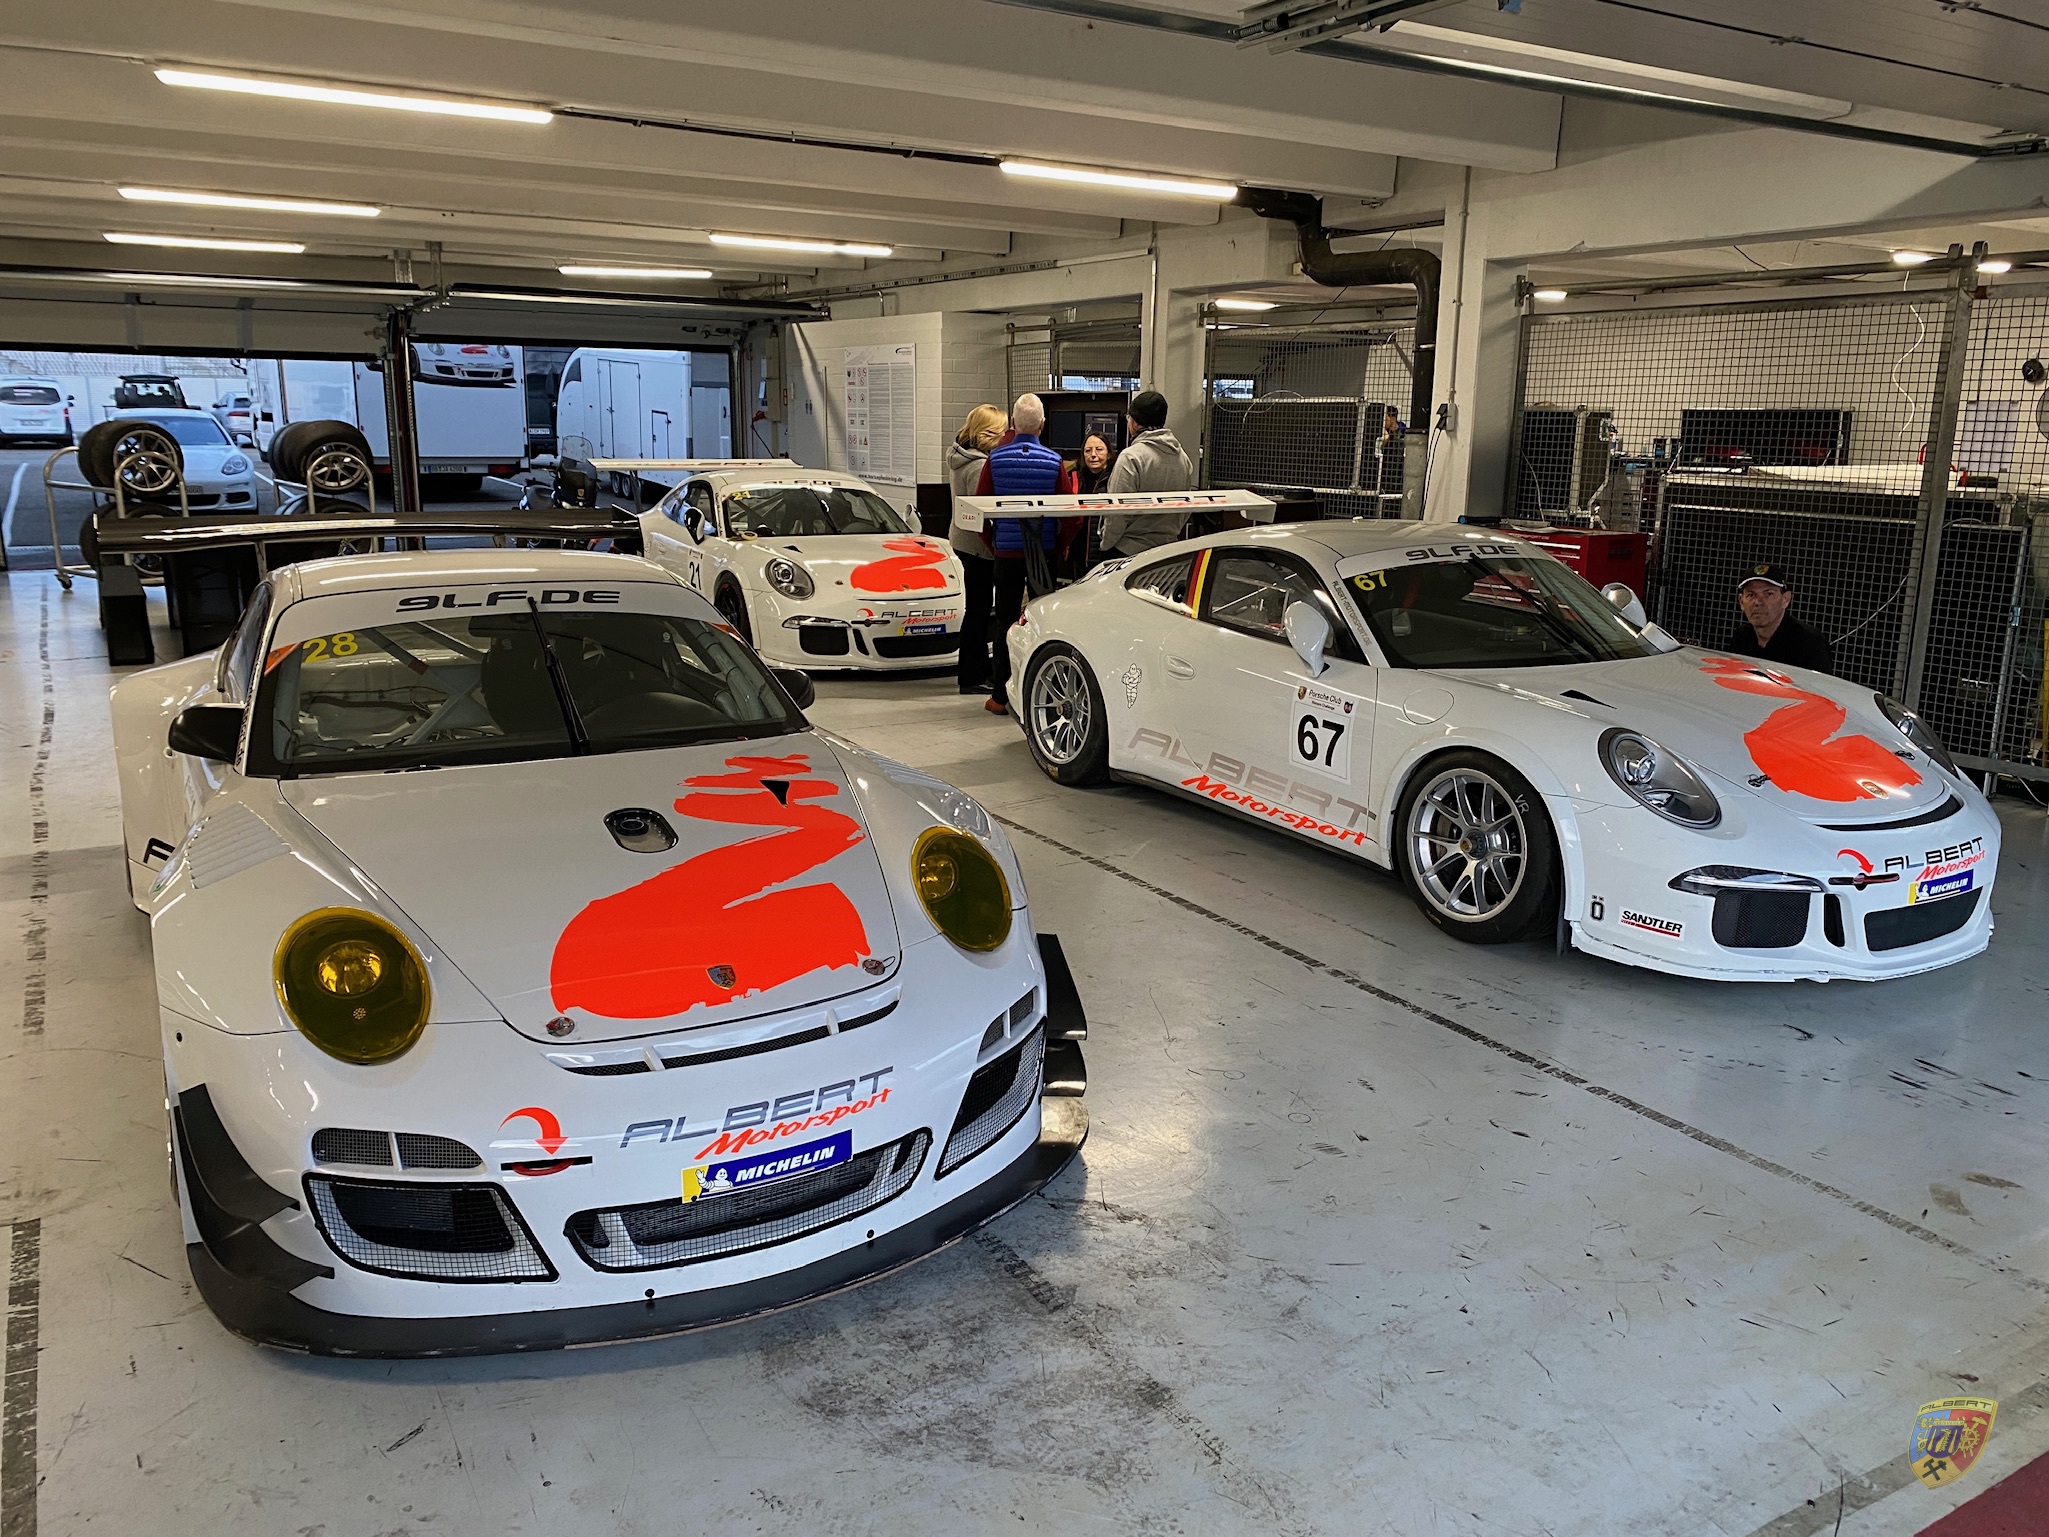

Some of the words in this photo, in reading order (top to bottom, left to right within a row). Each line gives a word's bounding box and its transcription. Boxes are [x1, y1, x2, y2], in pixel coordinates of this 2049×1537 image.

[732, 490, 752, 501] 21
[1406, 545, 1519, 561] 9LF.DE
[689, 561, 701, 591] 21
[1354, 570, 1388, 591] 67
[902, 614, 957, 625] Motorsport
[912, 626, 942, 634] MICHELIN
[302, 632, 358, 664] 28
[1308, 689, 1329, 701] Porsche
[1330, 695, 1342, 705] Club
[1297, 714, 1345, 767] 67
[1128, 727, 1377, 828] ALBERT
[1181, 774, 1368, 846] Motorsport
[1515, 793, 1530, 814] VR
[1885, 836, 1983, 872] ALBERT
[1915, 850, 1985, 881] Motorsport
[1930, 878, 1968, 895] MICHELIN
[1622, 910, 1683, 933] SANDTLER
[620, 1066, 893, 1149] ALBERT
[693, 1087, 892, 1160] Motorsport
[735, 1145, 836, 1183] MICHELIN
